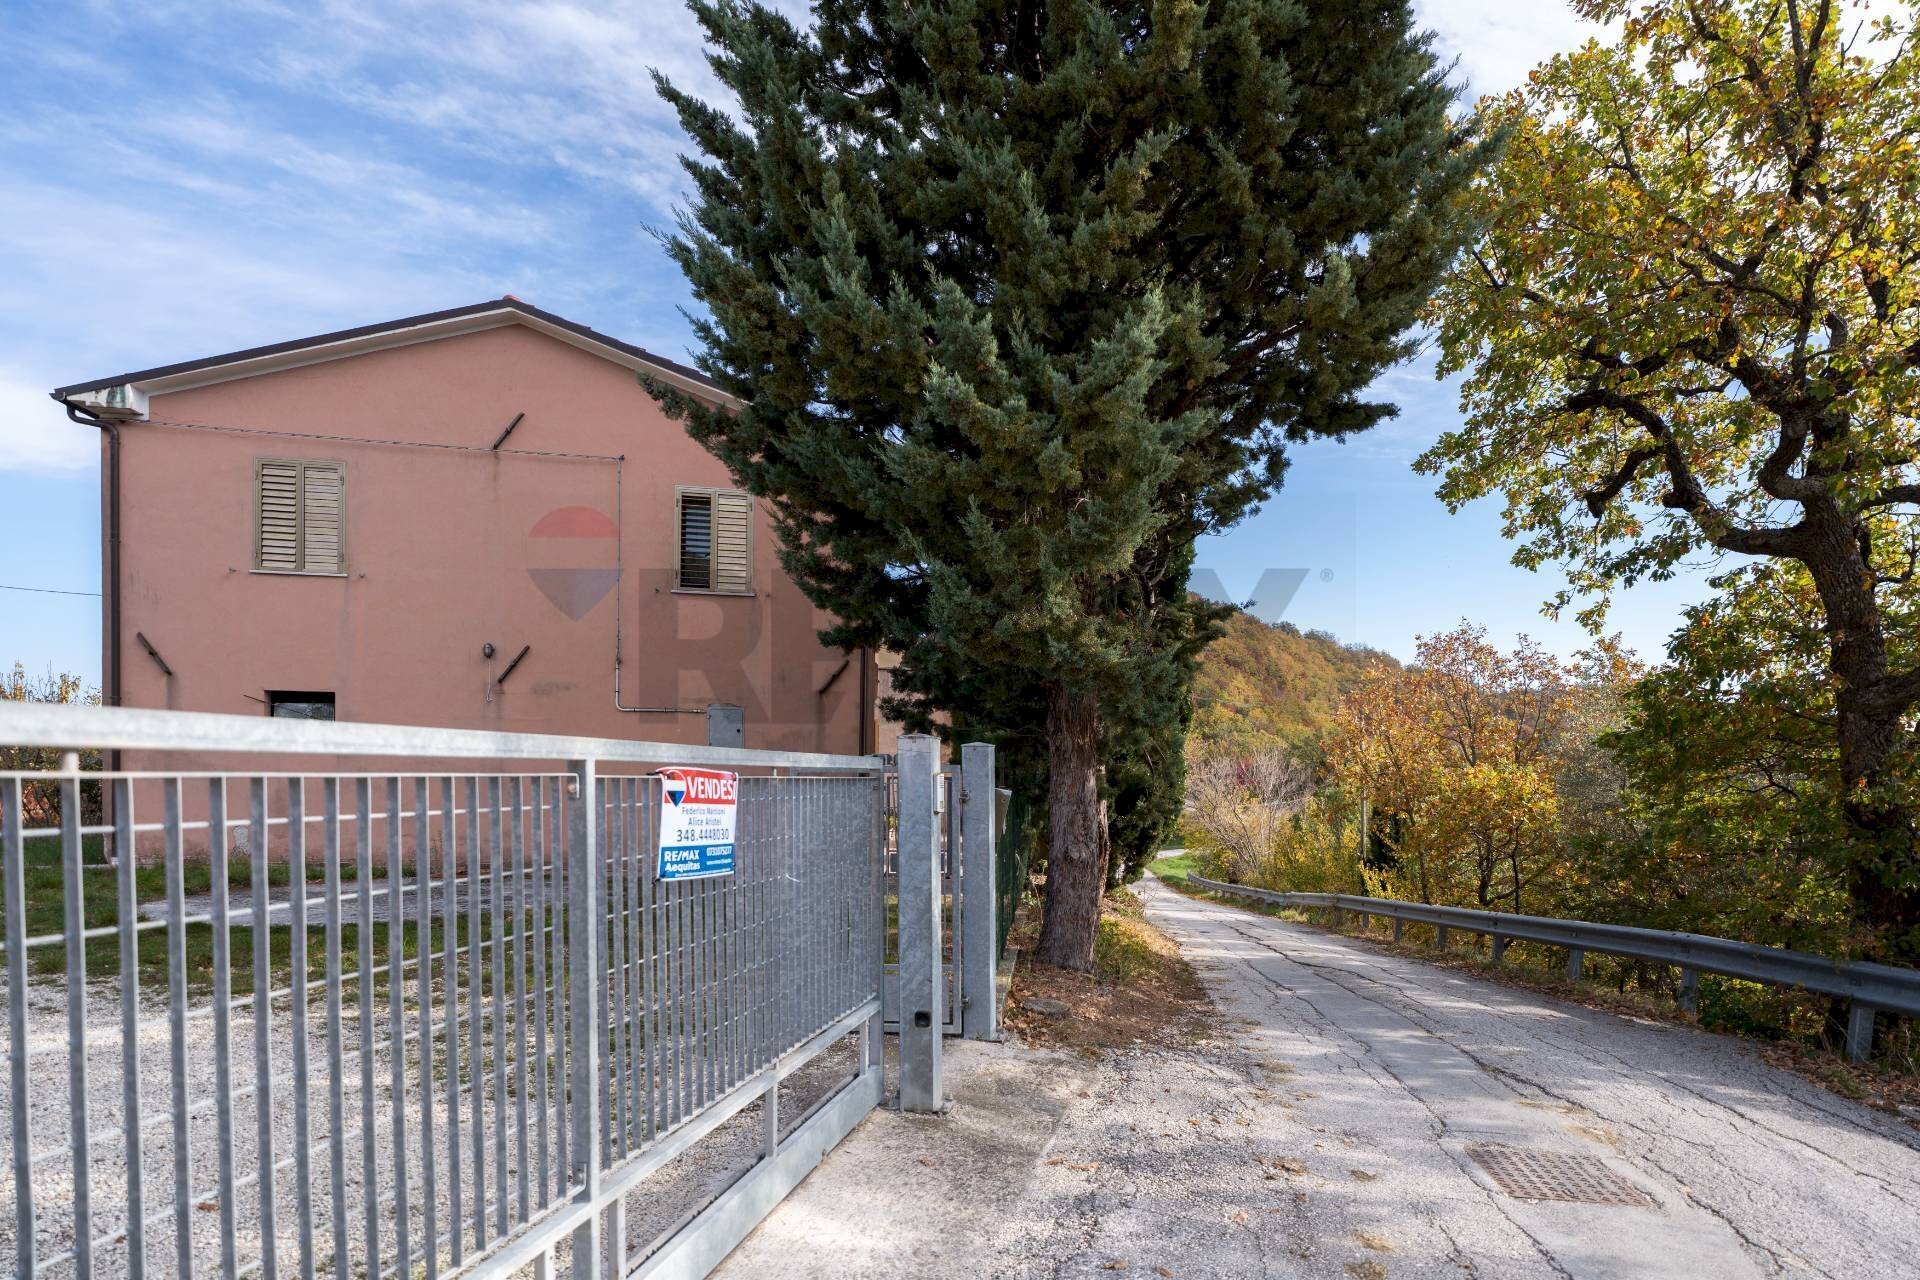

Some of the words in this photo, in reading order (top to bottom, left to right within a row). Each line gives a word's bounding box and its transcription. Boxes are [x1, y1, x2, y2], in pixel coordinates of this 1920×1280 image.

[686, 775, 736, 800] VENDESI
[664, 849, 700, 862] RE/MAX
[664, 860, 701, 873] Aequitas
